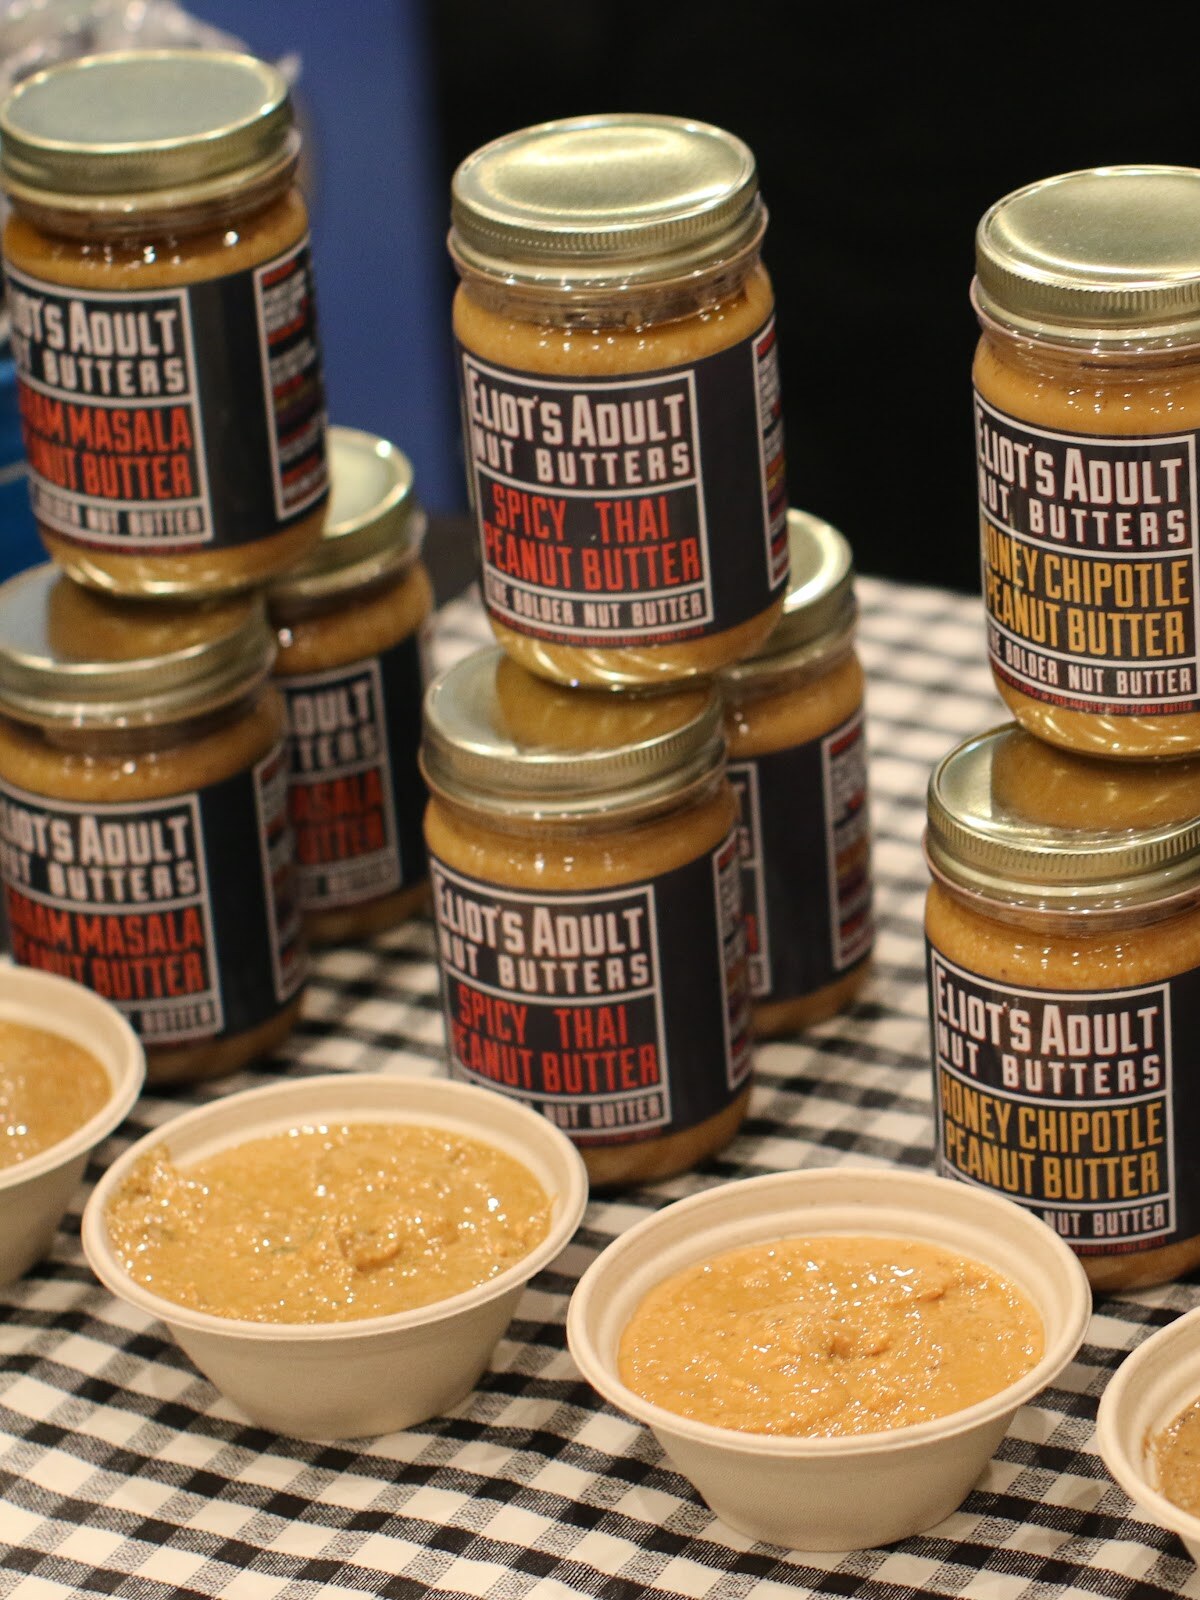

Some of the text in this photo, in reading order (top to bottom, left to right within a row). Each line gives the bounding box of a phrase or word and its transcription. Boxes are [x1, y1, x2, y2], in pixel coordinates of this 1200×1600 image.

[70, 301, 177, 356] ADULT
[43, 350, 184, 396] BUTTERS
[68, 404, 193, 451] MASALA
[468, 366, 685, 447] ELIOT'S ADULT
[83, 452, 193, 499] BUTTER
[474, 424, 691, 486] NUT BUTTERS
[976, 411, 1184, 506] ELIOT'S ADULT
[491, 483, 670, 545] SPICY THAI
[979, 465, 1186, 547] NUT BUTTERS
[483, 519, 700, 592] PEANUT BUTTER
[1043, 553, 1191, 608] CHIPOTLE
[584, 602, 621, 627] NUT
[632, 593, 703, 627] BUTTER
[986, 572, 1185, 657] PEANUT BUTTER
[293, 678, 371, 736] DULT
[1068, 664, 1104, 694] NUT
[1116, 667, 1192, 695] BUTTER
[79, 815, 189, 866] ADULT
[48, 860, 196, 901] BUTTERS
[77, 907, 206, 956] MASALA
[437, 873, 525, 954] ELIOT'S
[531, 906, 644, 958] ADULT
[91, 952, 206, 1001] BUTTER
[442, 929, 650, 994] NUT BUTTERS
[456, 983, 628, 1050] SPICY THAI
[938, 970, 1160, 1057] ELIOT'S ADULT
[451, 1017, 661, 1094] PEANUT BUTTER
[939, 1031, 1161, 1096] NUT BUTTERS
[589, 1094, 662, 1129] BUTTER
[942, 1069, 1164, 1155] HONEY CHIPOTLE
[945, 1120, 1160, 1200] PEANUT BUTTER
[1043, 1205, 1165, 1236] NUT BUTTER
